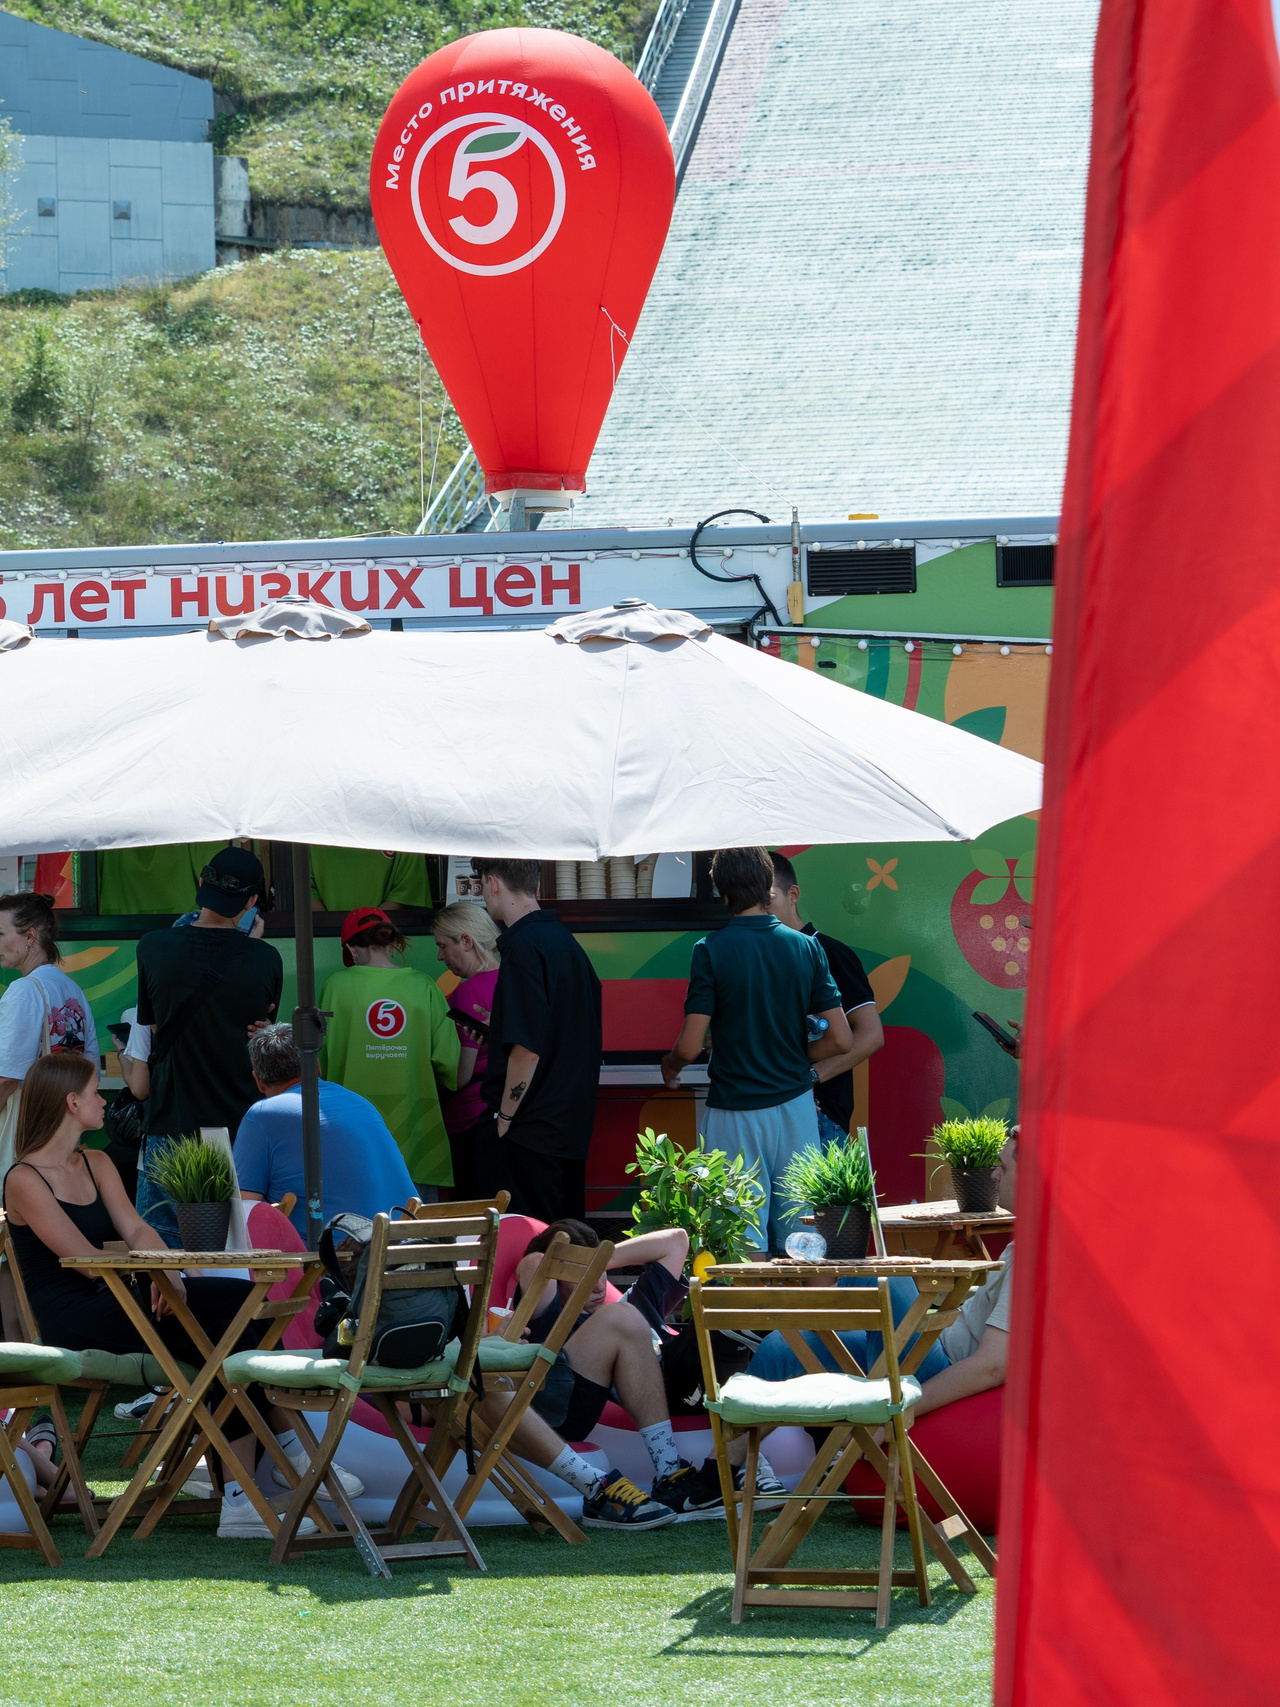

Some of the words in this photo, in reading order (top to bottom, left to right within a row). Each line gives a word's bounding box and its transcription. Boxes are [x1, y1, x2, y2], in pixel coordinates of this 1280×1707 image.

[385, 102, 433, 190] Место
[439, 78, 597, 171] притяжения
[448, 125, 527, 245] 5
[27, 579, 147, 624] лет
[170, 568, 426, 618] низких
[448, 564, 581, 615] цен
